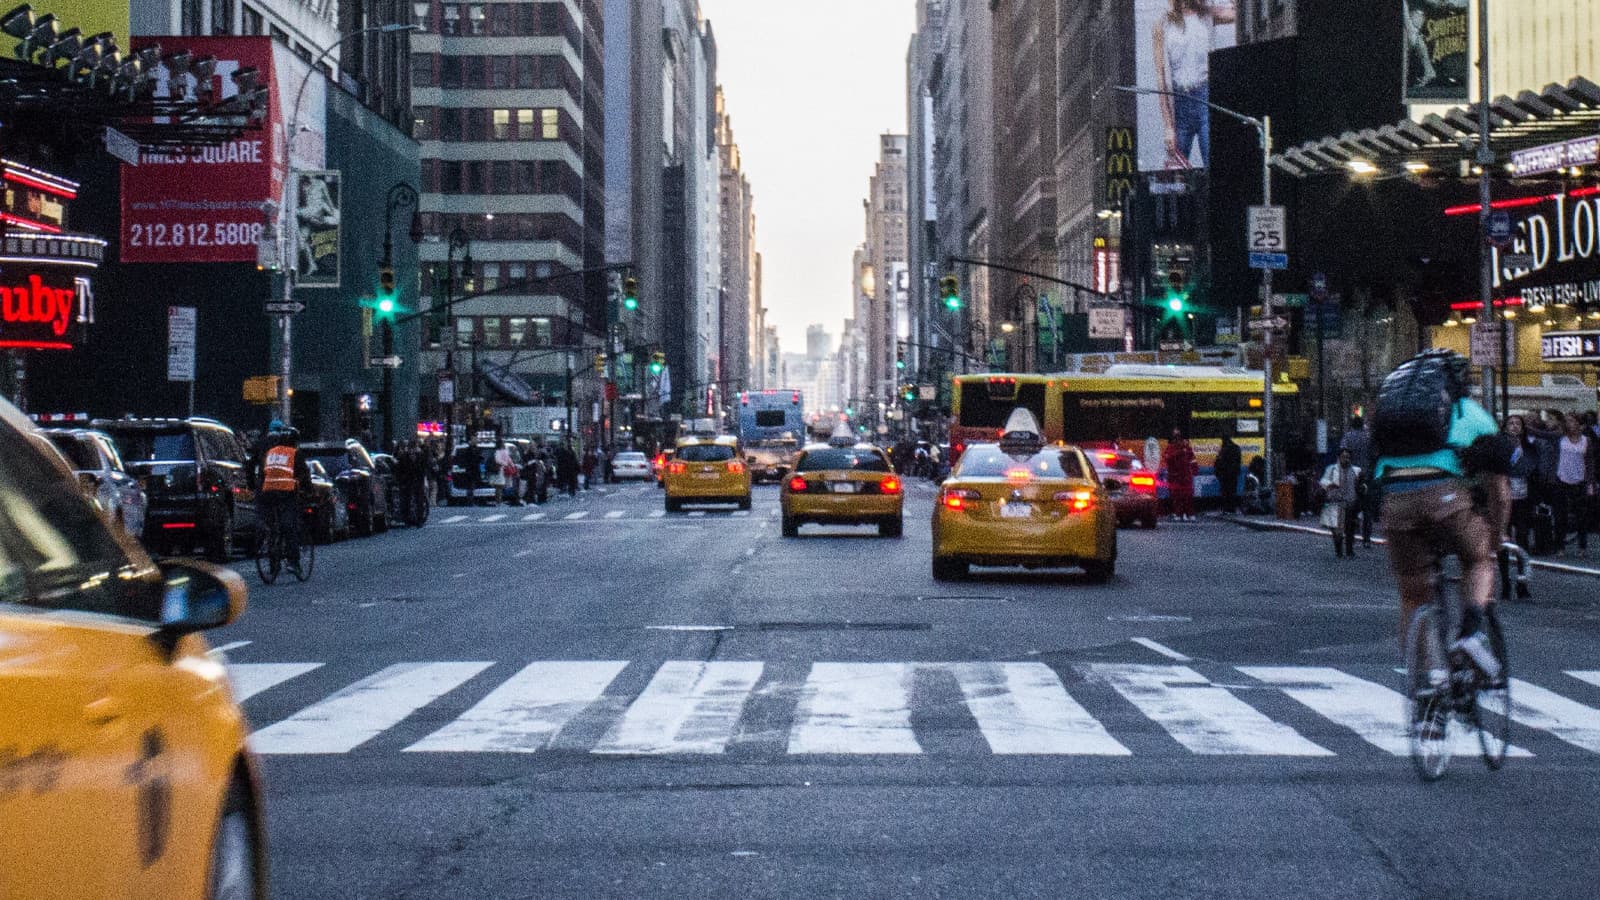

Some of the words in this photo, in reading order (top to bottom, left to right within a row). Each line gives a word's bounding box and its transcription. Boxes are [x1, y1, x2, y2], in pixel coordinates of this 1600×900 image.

[130, 222, 263, 246] 212.812.5808
[1253, 230, 1281, 247] 25
[1556, 193, 1600, 263] LO
[1520, 284, 1554, 308] FRESH
[1554, 281, 1579, 305] FISH
[1553, 336, 1583, 357] FISH
